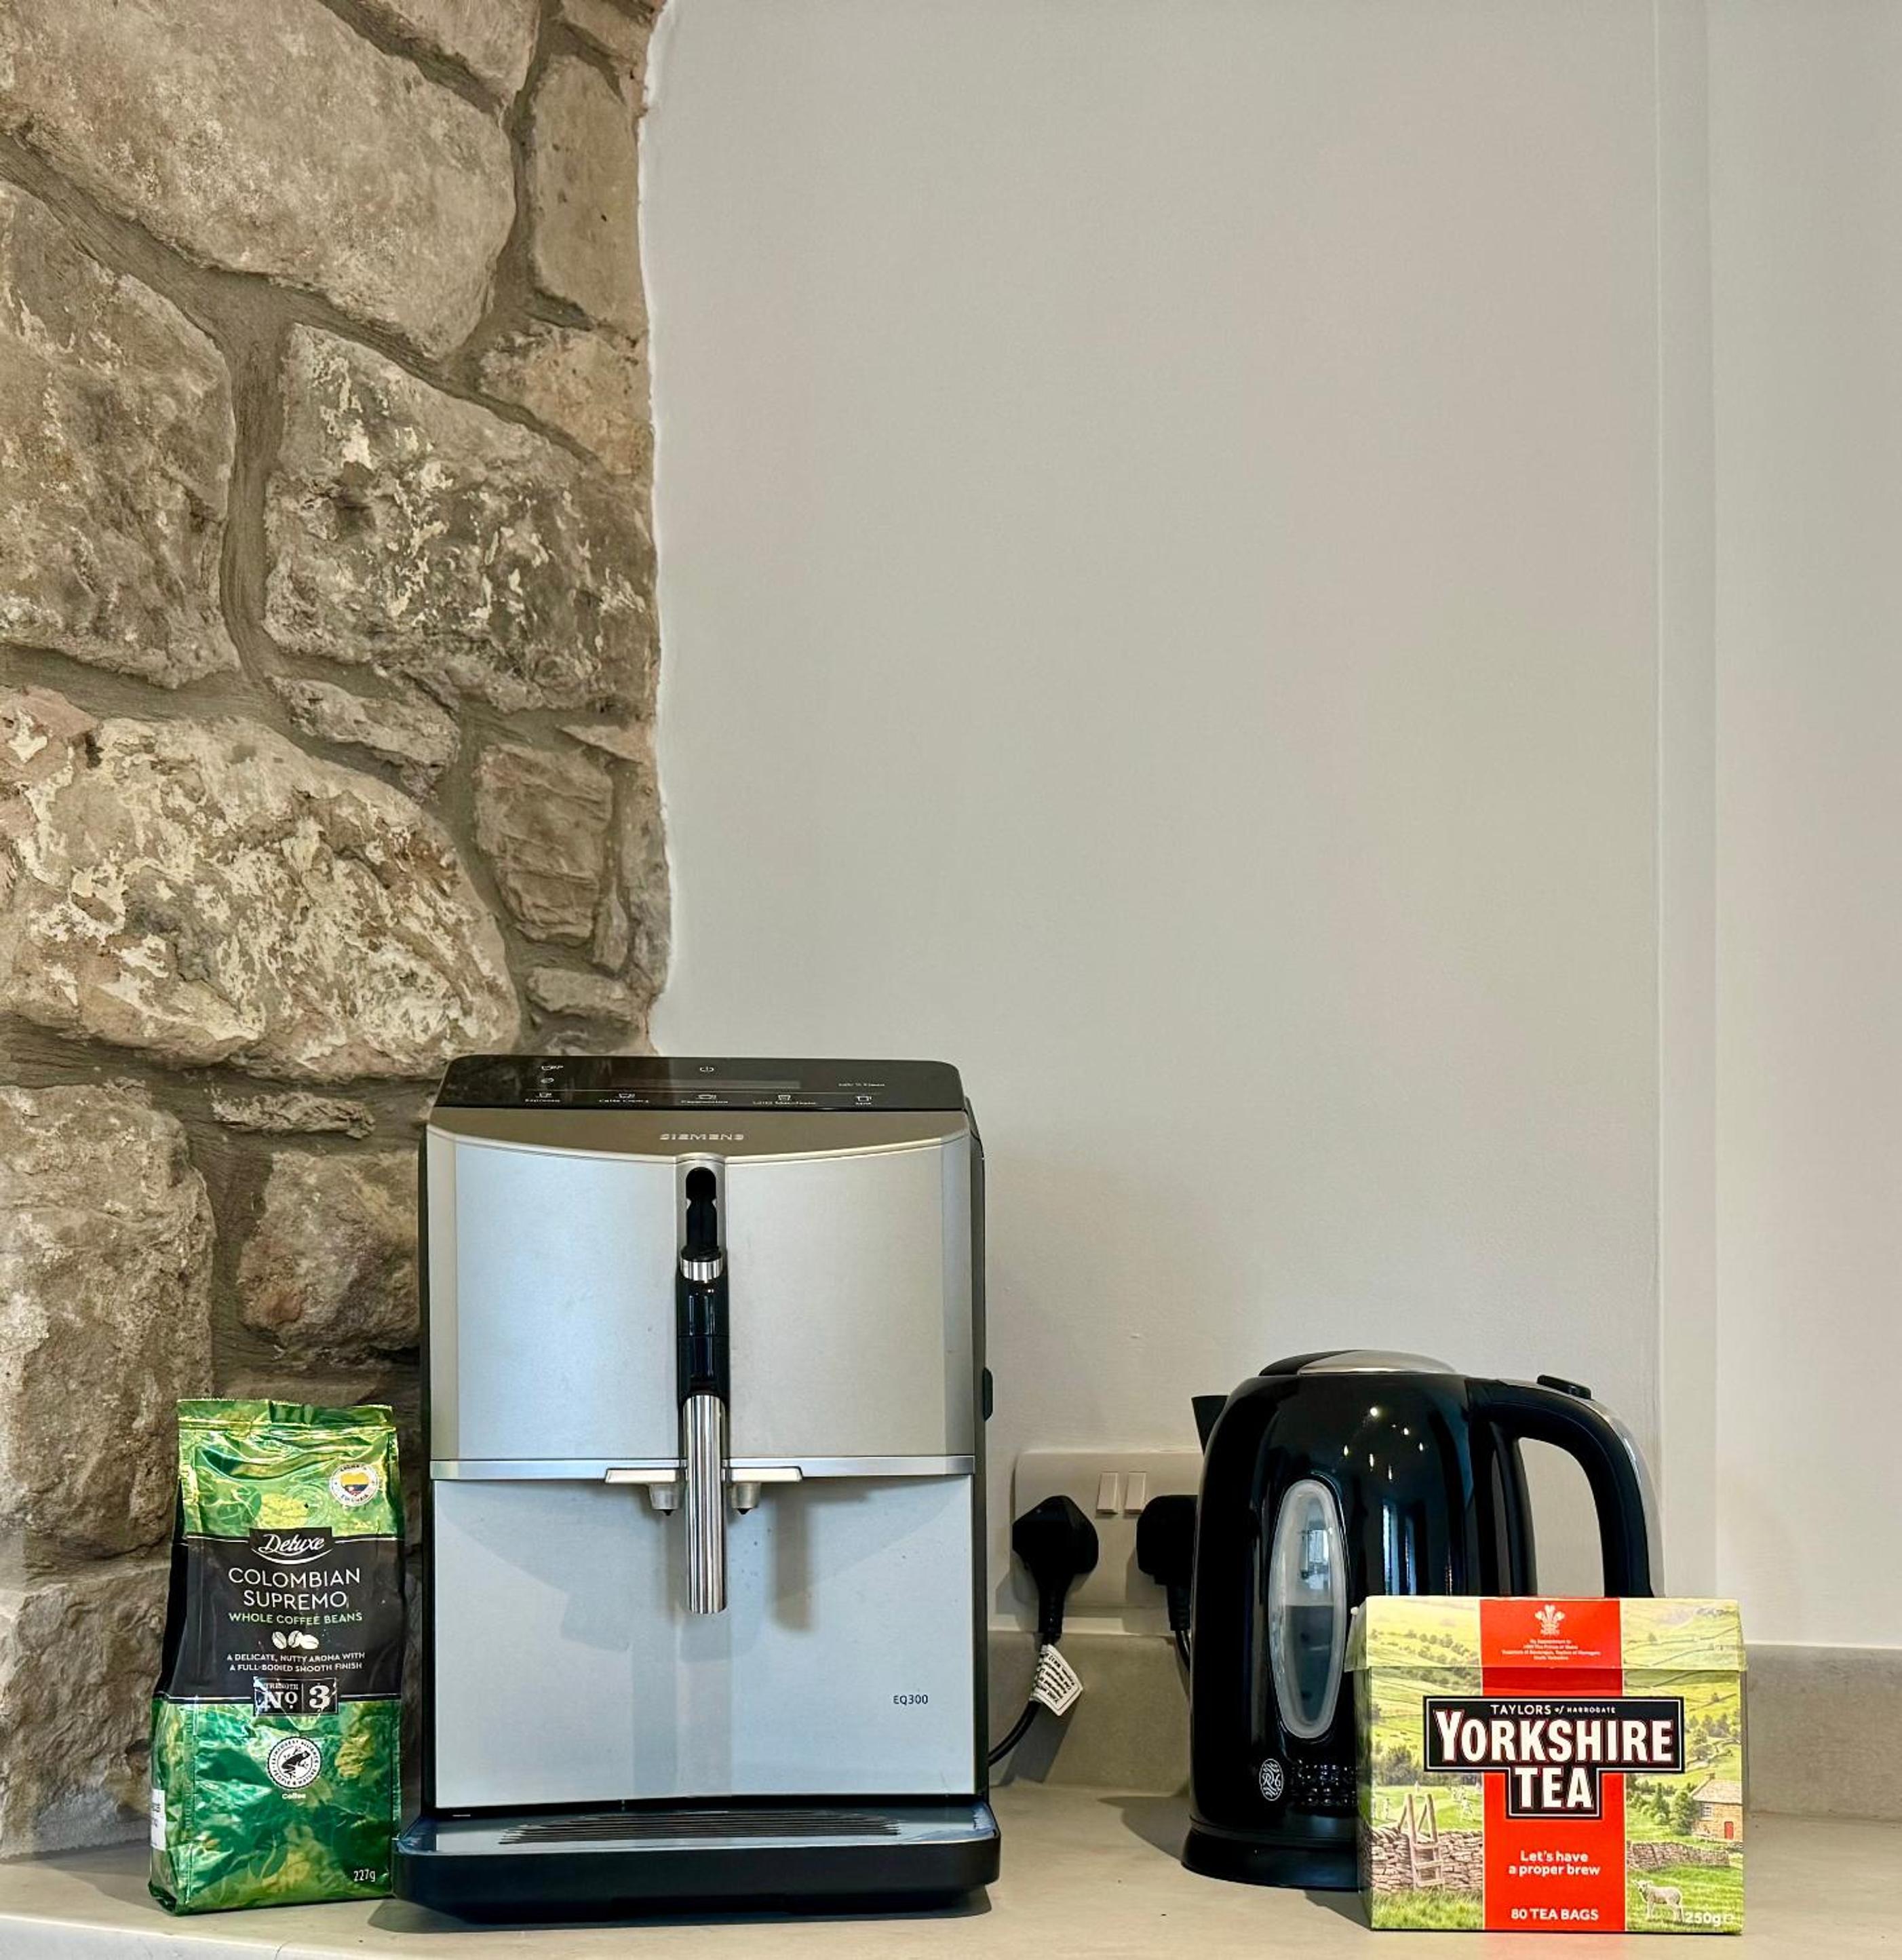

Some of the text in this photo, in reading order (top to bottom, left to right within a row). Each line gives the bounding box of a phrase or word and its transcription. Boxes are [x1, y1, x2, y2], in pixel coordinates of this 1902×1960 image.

[258, 1533, 325, 1556] Deluxe
[228, 1567, 360, 1588] COLOMBIAN
[244, 1590, 347, 1610] SUPREMO
[229, 1612, 363, 1625] WHOLE COFFEE BEANS
[235, 1653, 277, 1662] DELICATE,
[309, 1654, 340, 1662] AROMA
[295, 1664, 332, 1672] SMOOTH
[335, 1662, 362, 1670] FINISH
[309, 1685, 330, 1709] 3
[893, 1694, 928, 1706] EQ300
[1490, 1704, 1551, 1715] TAYLORS
[1433, 1709, 1674, 1763] YORKSHIRE
[1513, 1766, 1593, 1809] TEA
[1520, 1850, 1589, 1862] Let's have
[353, 1869, 376, 1883] 227g
[1509, 1864, 1601, 1877] a proper brew
[1511, 1908, 1599, 1921] 80 TEA BAGS
[1685, 1912, 1721, 1927] 250g
